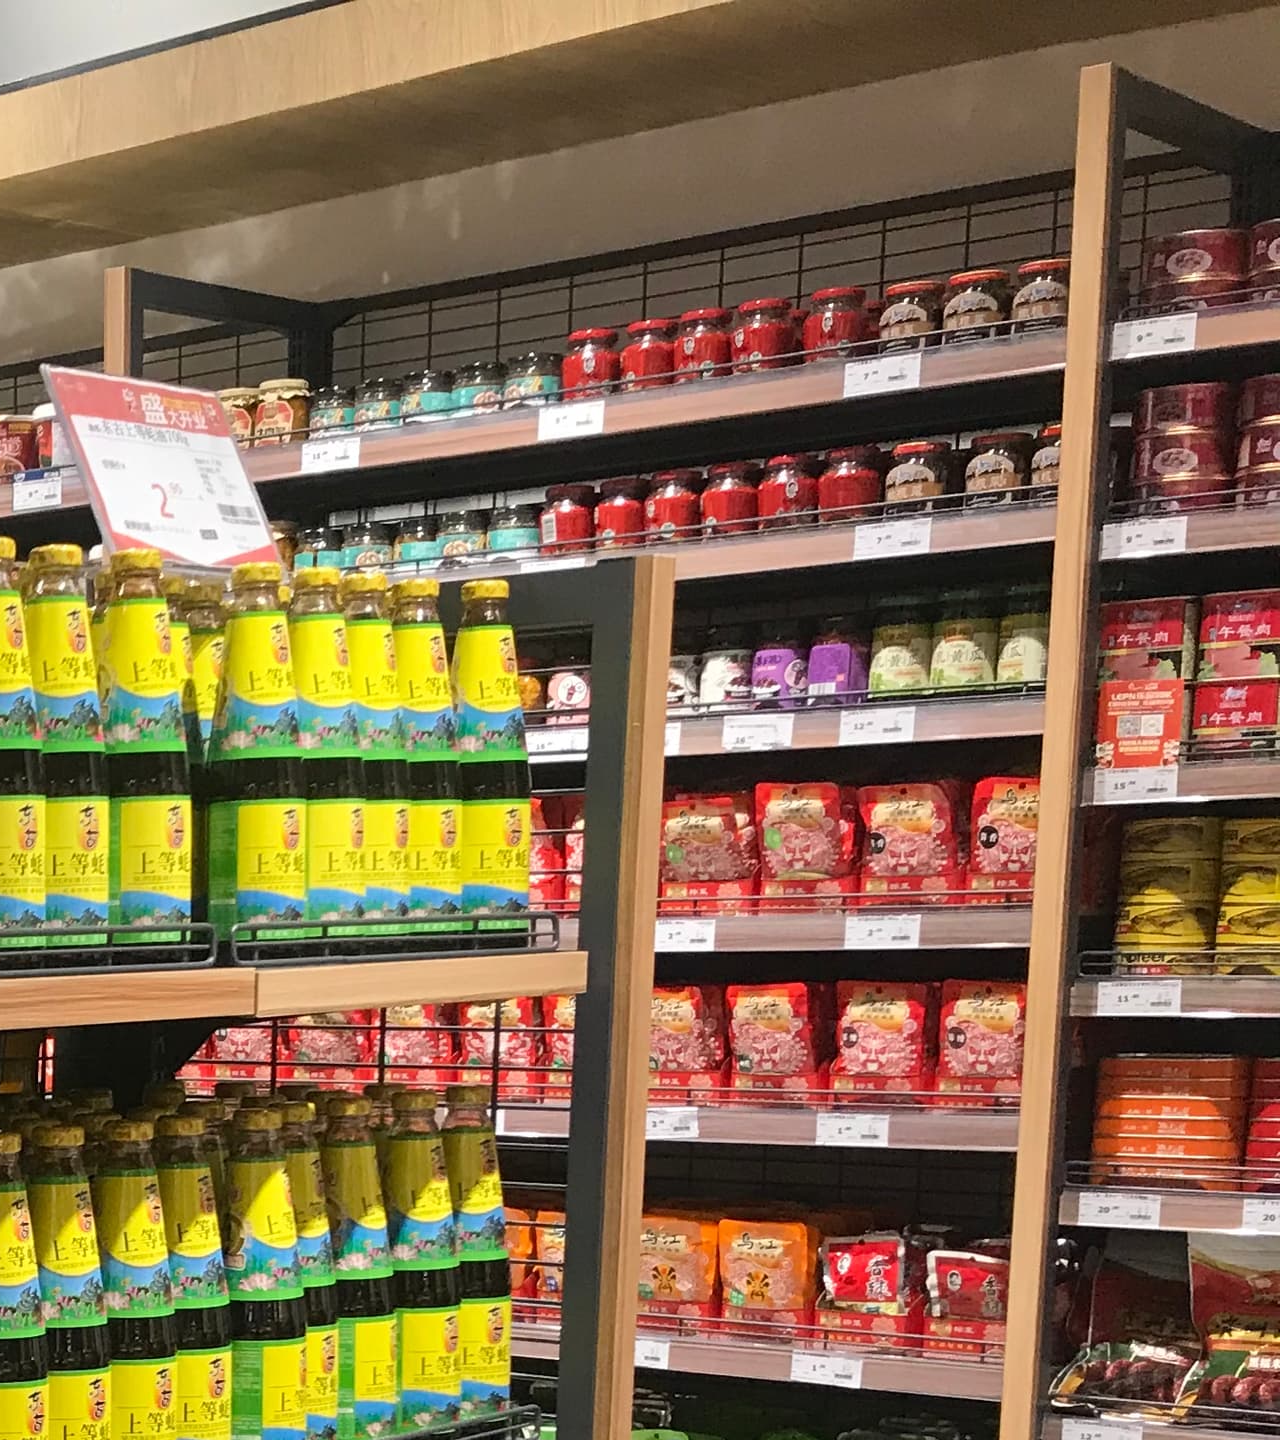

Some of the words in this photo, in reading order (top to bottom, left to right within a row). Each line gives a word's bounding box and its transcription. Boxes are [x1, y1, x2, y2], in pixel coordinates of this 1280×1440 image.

[141, 393, 208, 429] 盛大开业
[1117, 631, 1169, 645] 午餐肉
[1217, 624, 1272, 639] 午餐肉
[1208, 711, 1263, 725] 午餐肉
[640, 1229, 681, 1246] 乌江
[738, 1231, 778, 1250] 乌江
